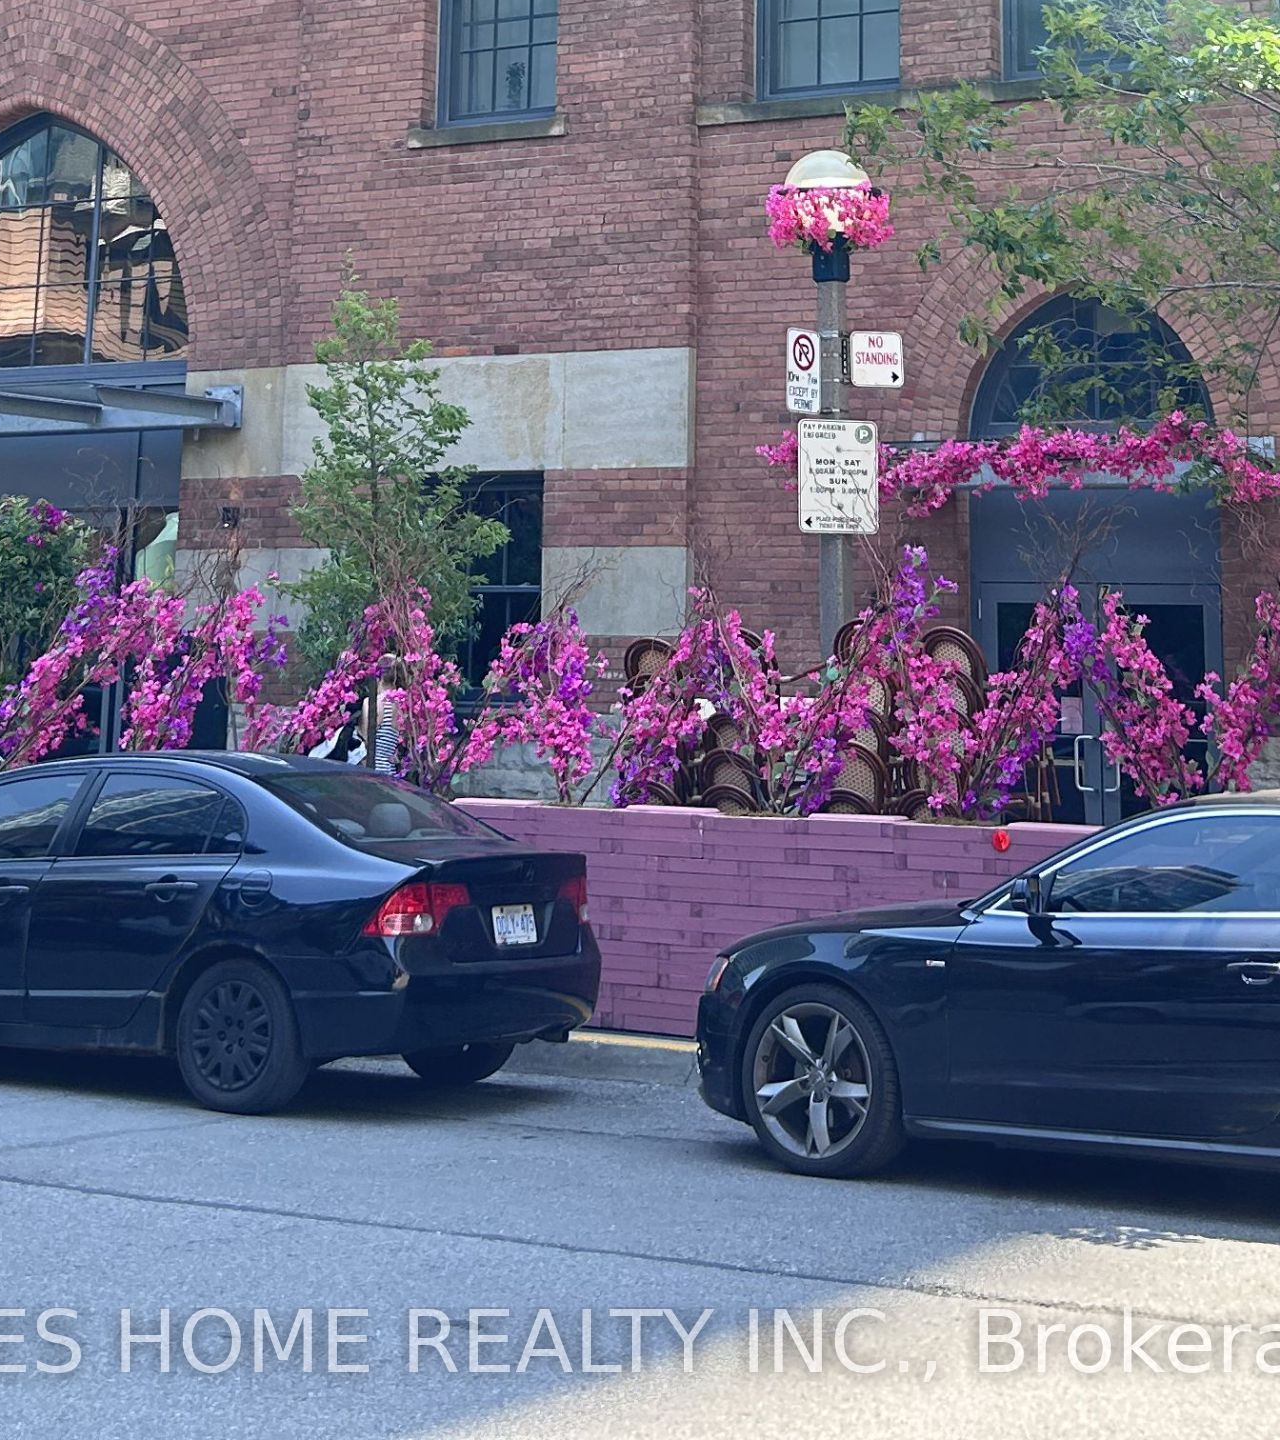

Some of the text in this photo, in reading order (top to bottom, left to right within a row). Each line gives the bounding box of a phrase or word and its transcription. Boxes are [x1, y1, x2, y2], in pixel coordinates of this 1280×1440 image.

[868, 336, 883, 348] NO
[855, 352, 898, 366] STANDING
[815, 458, 861, 467] MON SAT
